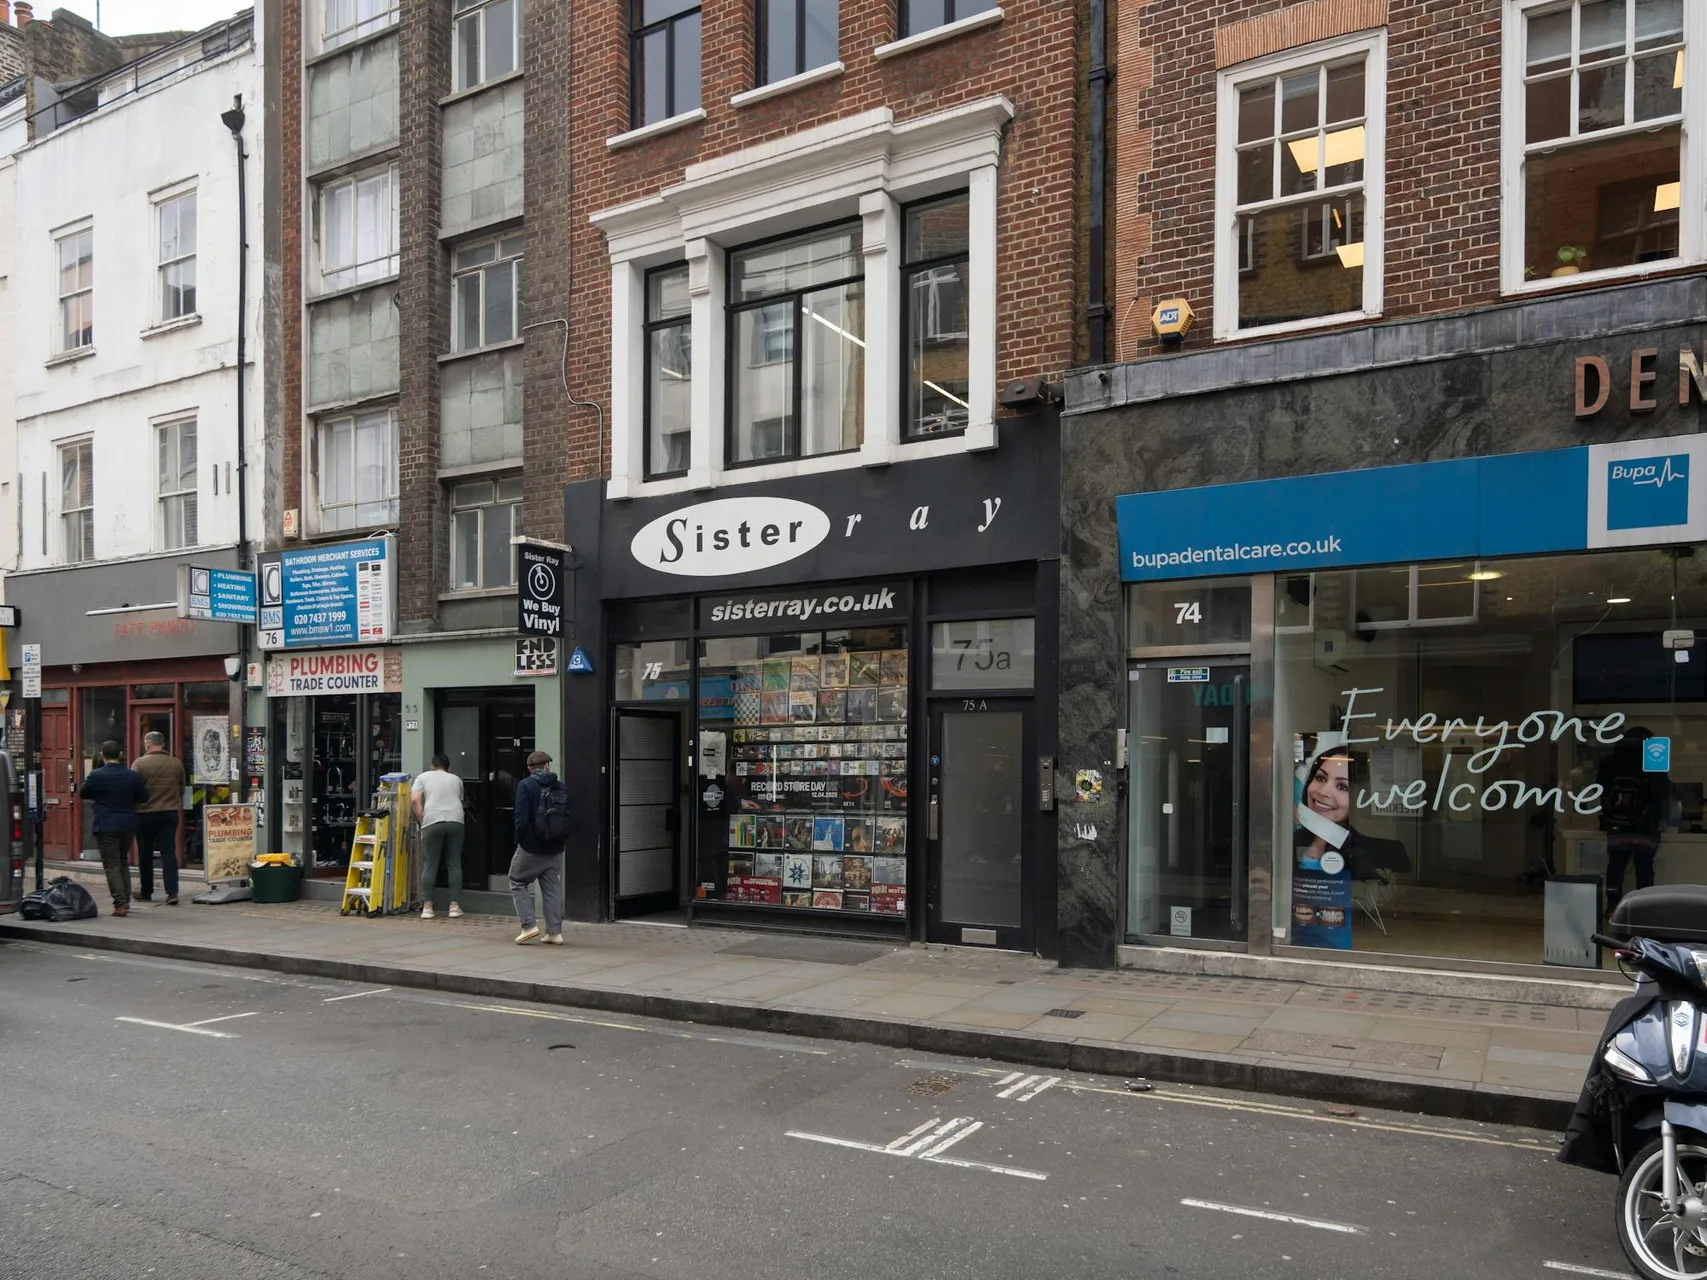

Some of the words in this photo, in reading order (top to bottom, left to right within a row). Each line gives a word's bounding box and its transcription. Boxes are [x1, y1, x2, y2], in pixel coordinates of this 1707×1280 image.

[1160, 311, 1178, 322] ADT
[1575, 339, 1707, 419] DEN
[1612, 465, 1656, 481] Bupa
[659, 517, 803, 564] Sister
[285, 555, 316, 566] BATHROOM
[317, 551, 349, 562] MERCHANT
[350, 547, 380, 559] SERVICES
[524, 551, 545, 563] Sister
[546, 555, 560, 567] Ray
[1133, 535, 1342, 569] bupadentalcare.co.uk
[217, 573, 252, 582] PLUMBING
[217, 583, 246, 592] HEATING
[190, 597, 208, 606] BMS
[217, 593, 250, 602] SANITARY
[711, 587, 897, 622] sisterray.co.uk
[523, 599, 540, 612] We
[541, 601, 560, 616] Buy
[1174, 602, 1202, 624] 74
[261, 610, 281, 625] BMS
[294, 614, 308, 625] 020
[309, 612, 326, 623] 7437
[328, 611, 347, 622] 1999
[523, 613, 560, 635] Vinyl
[290, 623, 351, 636] www.bmsw1.com
[265, 632, 278, 645] 76
[953, 638, 1011, 671] 75a
[290, 653, 379, 677] PLUMBING
[641, 662, 663, 680] 75
[290, 678, 324, 691] TRADE
[327, 675, 379, 689] COUNTER
[963, 699, 975, 711] 75
[979, 700, 988, 711] A
[1340, 687, 1626, 773] Everyone
[513, 739, 520, 747] 76
[784, 780, 811, 792] STORE
[811, 781, 826, 792] DAY
[1357, 754, 1604, 814] welcome
[208, 829, 253, 838] PLUMBING
